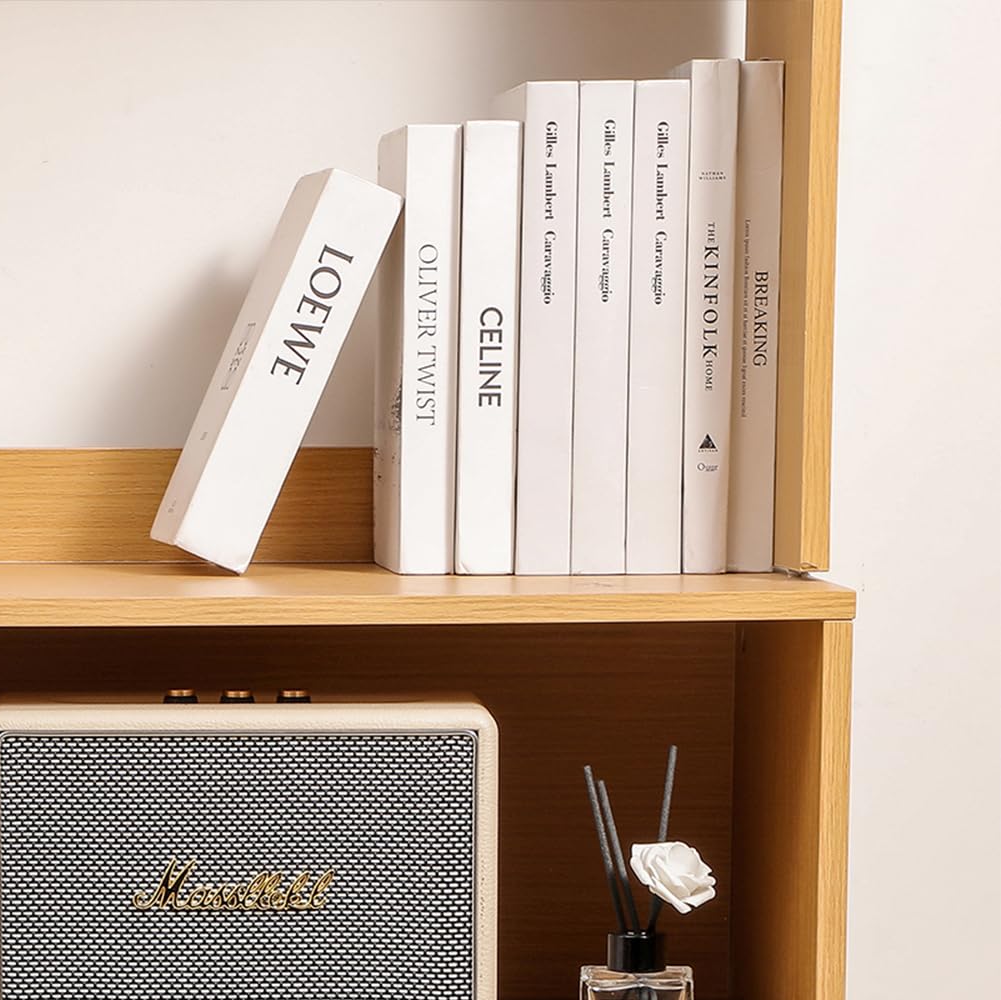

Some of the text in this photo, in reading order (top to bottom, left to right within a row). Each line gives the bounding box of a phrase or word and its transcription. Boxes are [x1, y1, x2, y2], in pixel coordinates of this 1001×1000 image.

[541, 121, 558, 305] Gilles Lambert Caravaggio
[599, 119, 616, 303] Gilles Lambert Caravaggio
[652, 121, 669, 305] Gilles Lambert Caravaggio
[270, 244, 354, 385] LOEWE
[416, 244, 438, 426] OLIVER TWIST
[478, 307, 503, 407] CELINE
[703, 222, 719, 392] THE KINFOLK HOME
[753, 271, 769, 367] BREAKING
